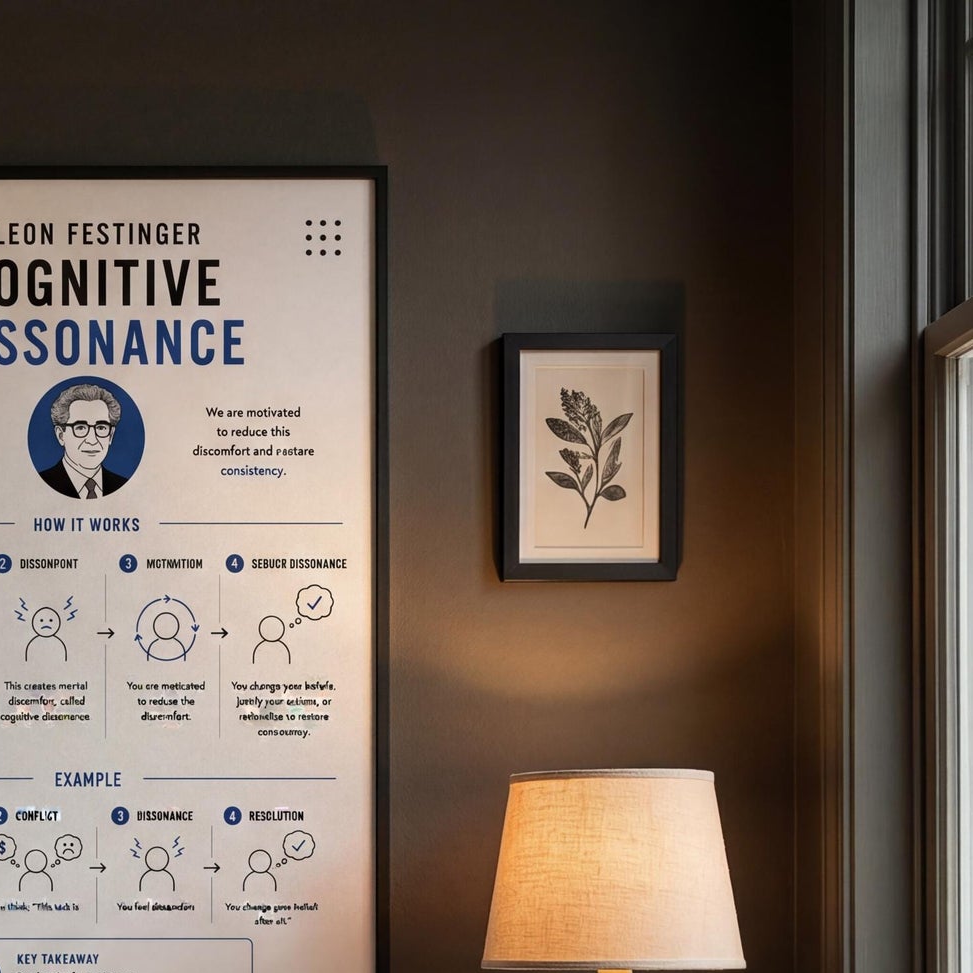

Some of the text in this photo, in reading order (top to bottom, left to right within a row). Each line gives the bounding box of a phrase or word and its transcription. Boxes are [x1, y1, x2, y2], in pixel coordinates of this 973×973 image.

[68, 223, 200, 245] FESTINGER
[206, 406, 301, 418] We are motivated
[217, 426, 291, 437] to reduce this
[192, 444, 250, 456] discomfort
[253, 445, 273, 456] and
[221, 465, 287, 478] consistency.
[34, 518, 140, 532] HOW IT WORKS
[0, 558, 7, 570] 2
[125, 557, 132, 570] 3
[231, 558, 239, 569] 4
[290, 558, 347, 569] DISSONANCE
[4, 681, 22, 690] This
[127, 681, 143, 691] You
[231, 681, 247, 691] You
[137, 697, 146, 706] to
[181, 696, 195, 706] the
[55, 772, 122, 787] EXAMPLE
[117, 811, 124, 821] 3
[229, 811, 236, 821] 4
[72, 903, 79, 911] is
[117, 902, 133, 911] You
[225, 903, 240, 911] You
[17, 953, 99, 965] KEY TAKEAWAY
